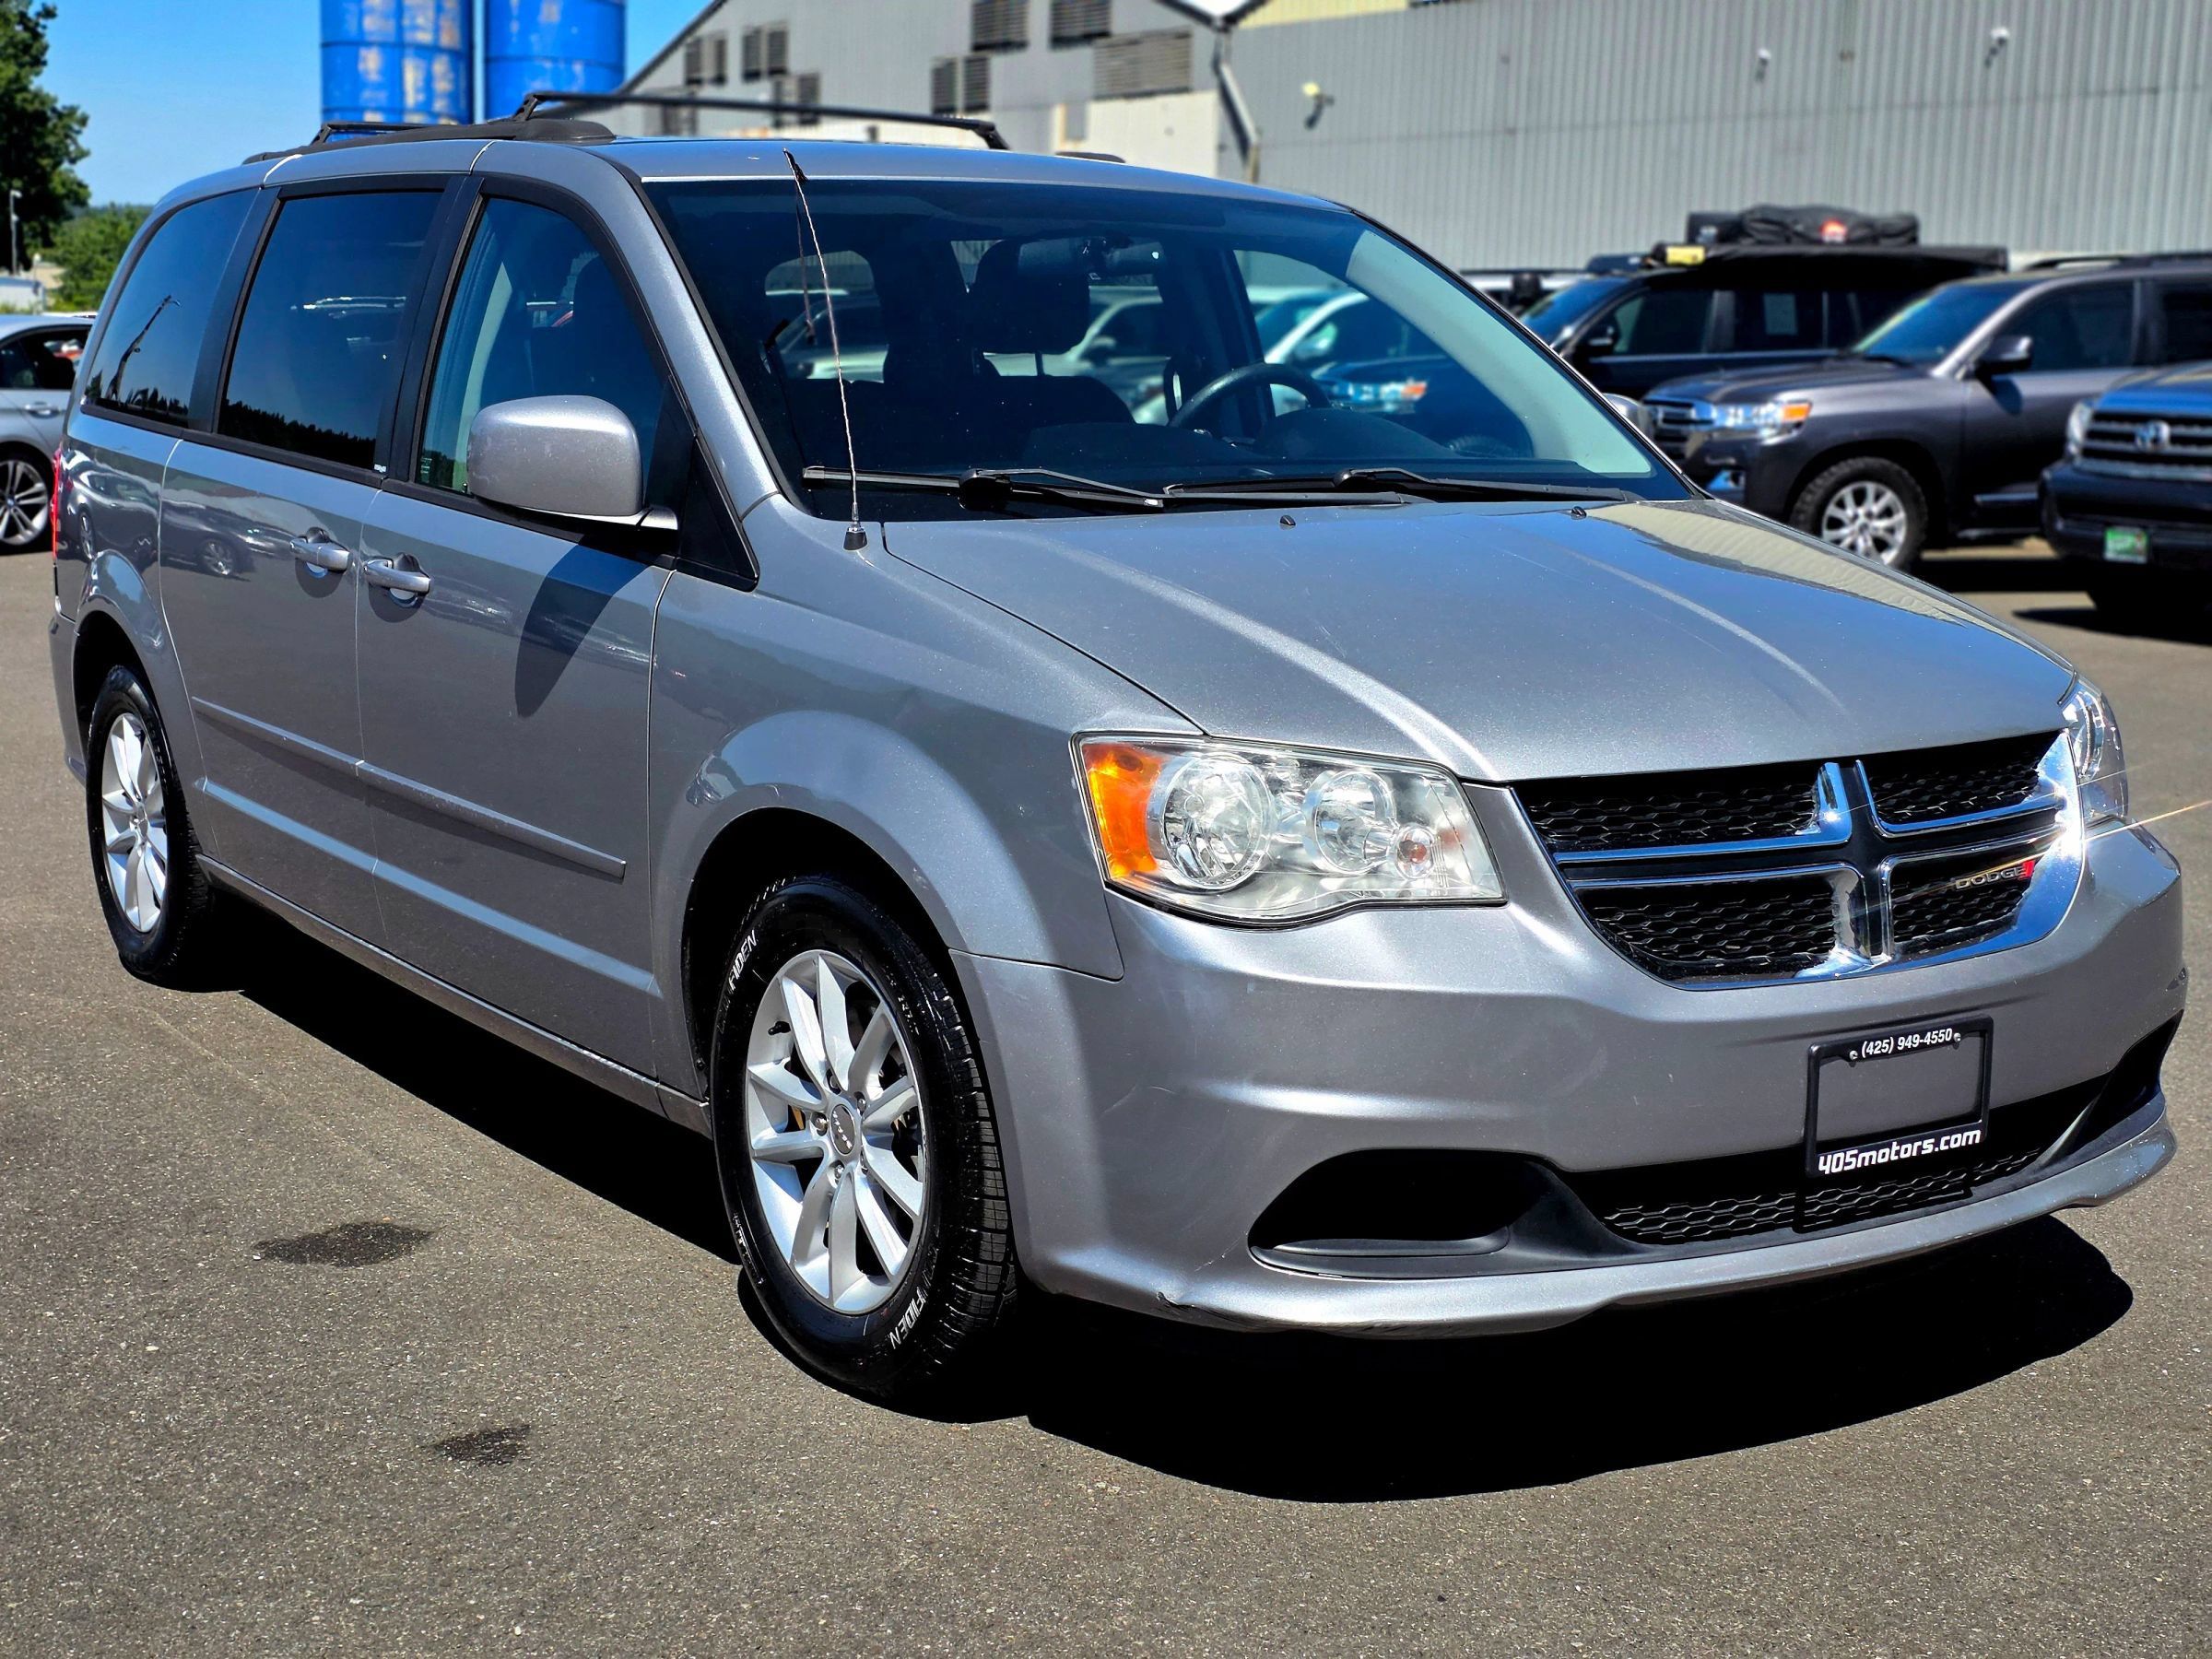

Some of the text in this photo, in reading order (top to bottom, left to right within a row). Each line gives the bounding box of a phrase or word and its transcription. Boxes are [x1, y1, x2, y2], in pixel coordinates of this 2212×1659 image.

[1955, 866, 2025, 889] DODGE
[1861, 1028, 1953, 1058] (425) 949-4550
[1818, 1129, 1982, 1175] 405motors.com
